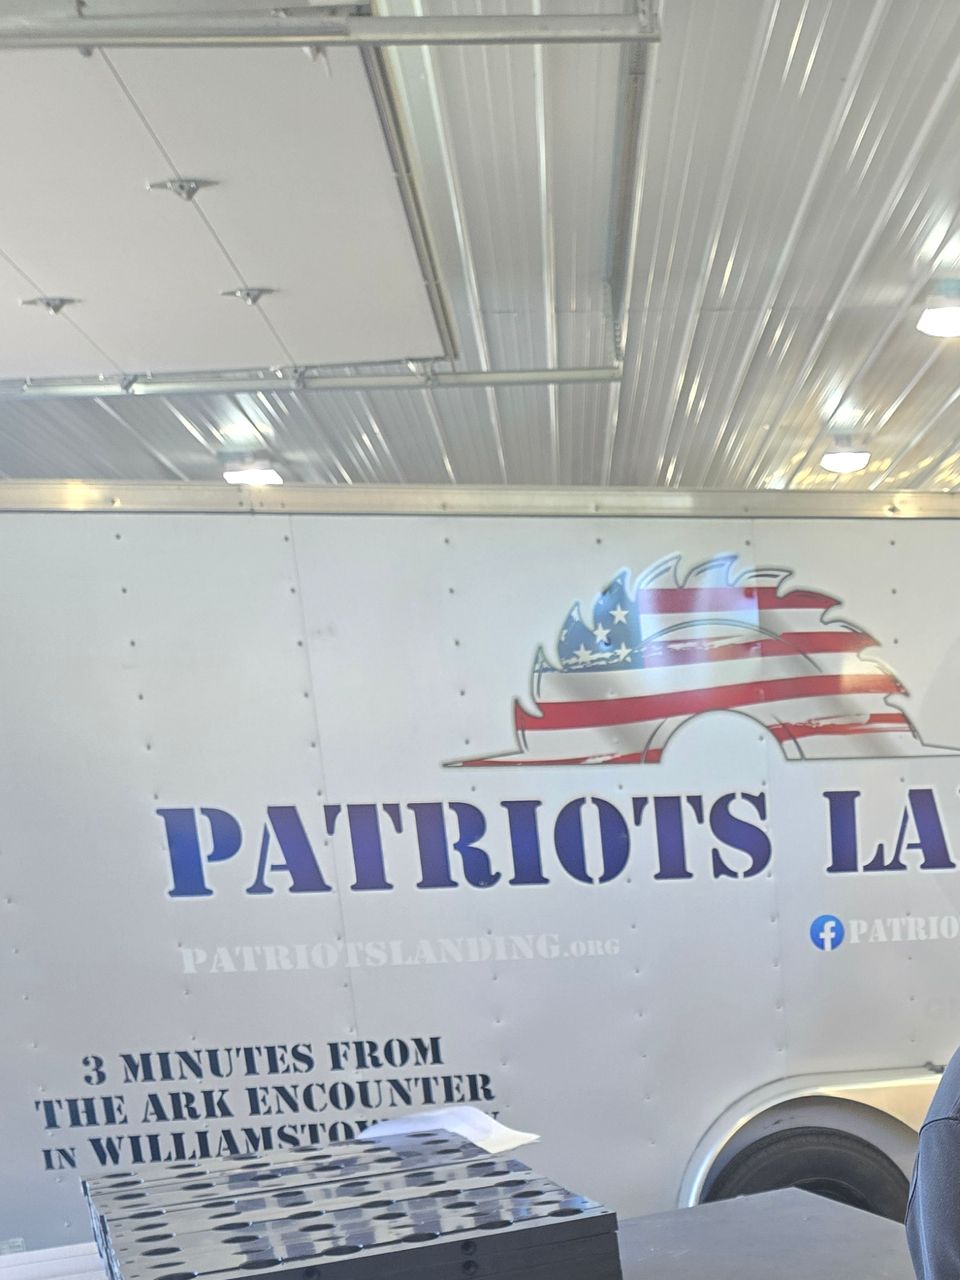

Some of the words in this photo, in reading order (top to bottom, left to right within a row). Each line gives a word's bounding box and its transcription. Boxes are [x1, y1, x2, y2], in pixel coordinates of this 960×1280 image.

[155, 791, 772, 898] PATRIOTS
[82, 1054, 107, 1086] 3
[119, 1043, 315, 1084] MINUTES
[327, 1036, 444, 1072] FROM
[35, 1094, 128, 1130] THE
[141, 1089, 235, 1123] ARK
[247, 1073, 496, 1118] ENCOUNTER
[42, 1147, 77, 1171] IN
[88, 1112, 499, 1167] WILLIAMSTO
